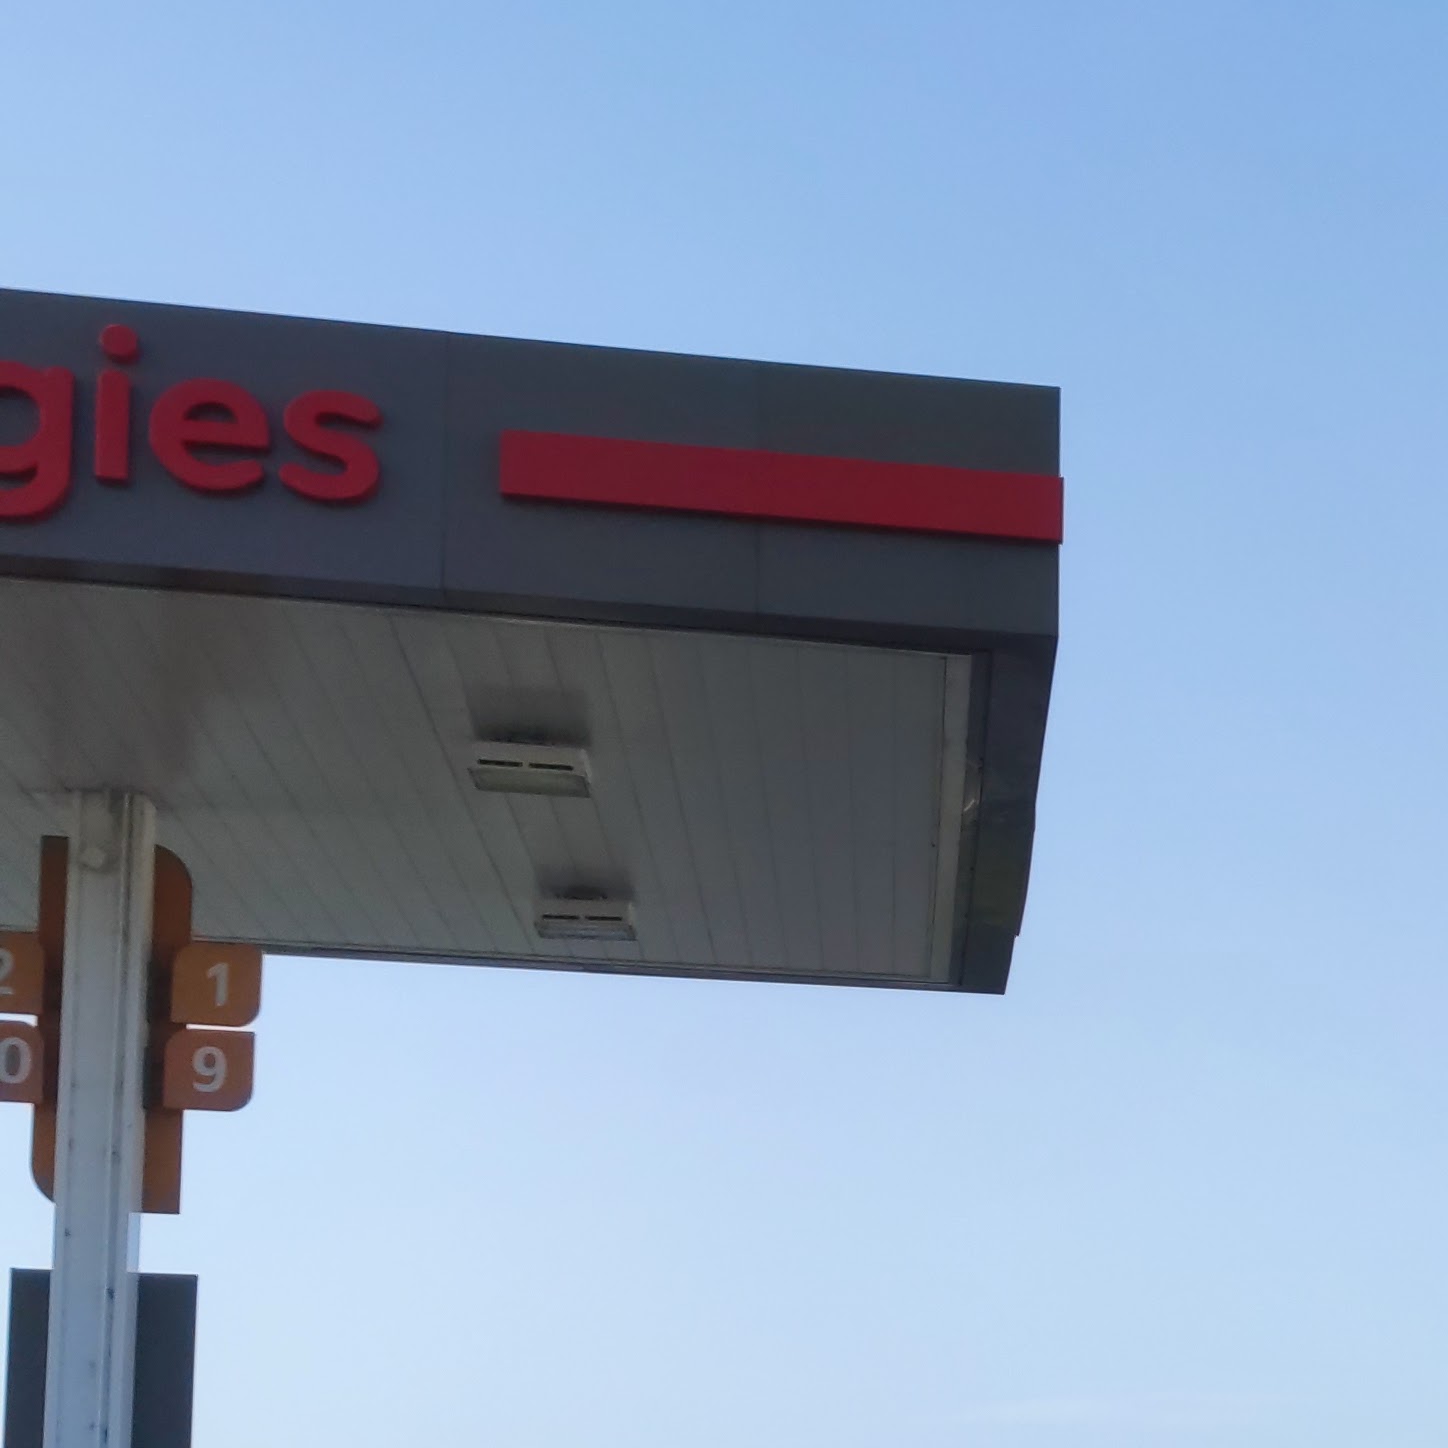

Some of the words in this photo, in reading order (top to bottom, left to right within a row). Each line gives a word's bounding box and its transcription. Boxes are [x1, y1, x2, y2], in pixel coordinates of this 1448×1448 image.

[0, 323, 383, 522] gies
[206, 962, 230, 1007] 1
[192, 1045, 228, 1093] 9
